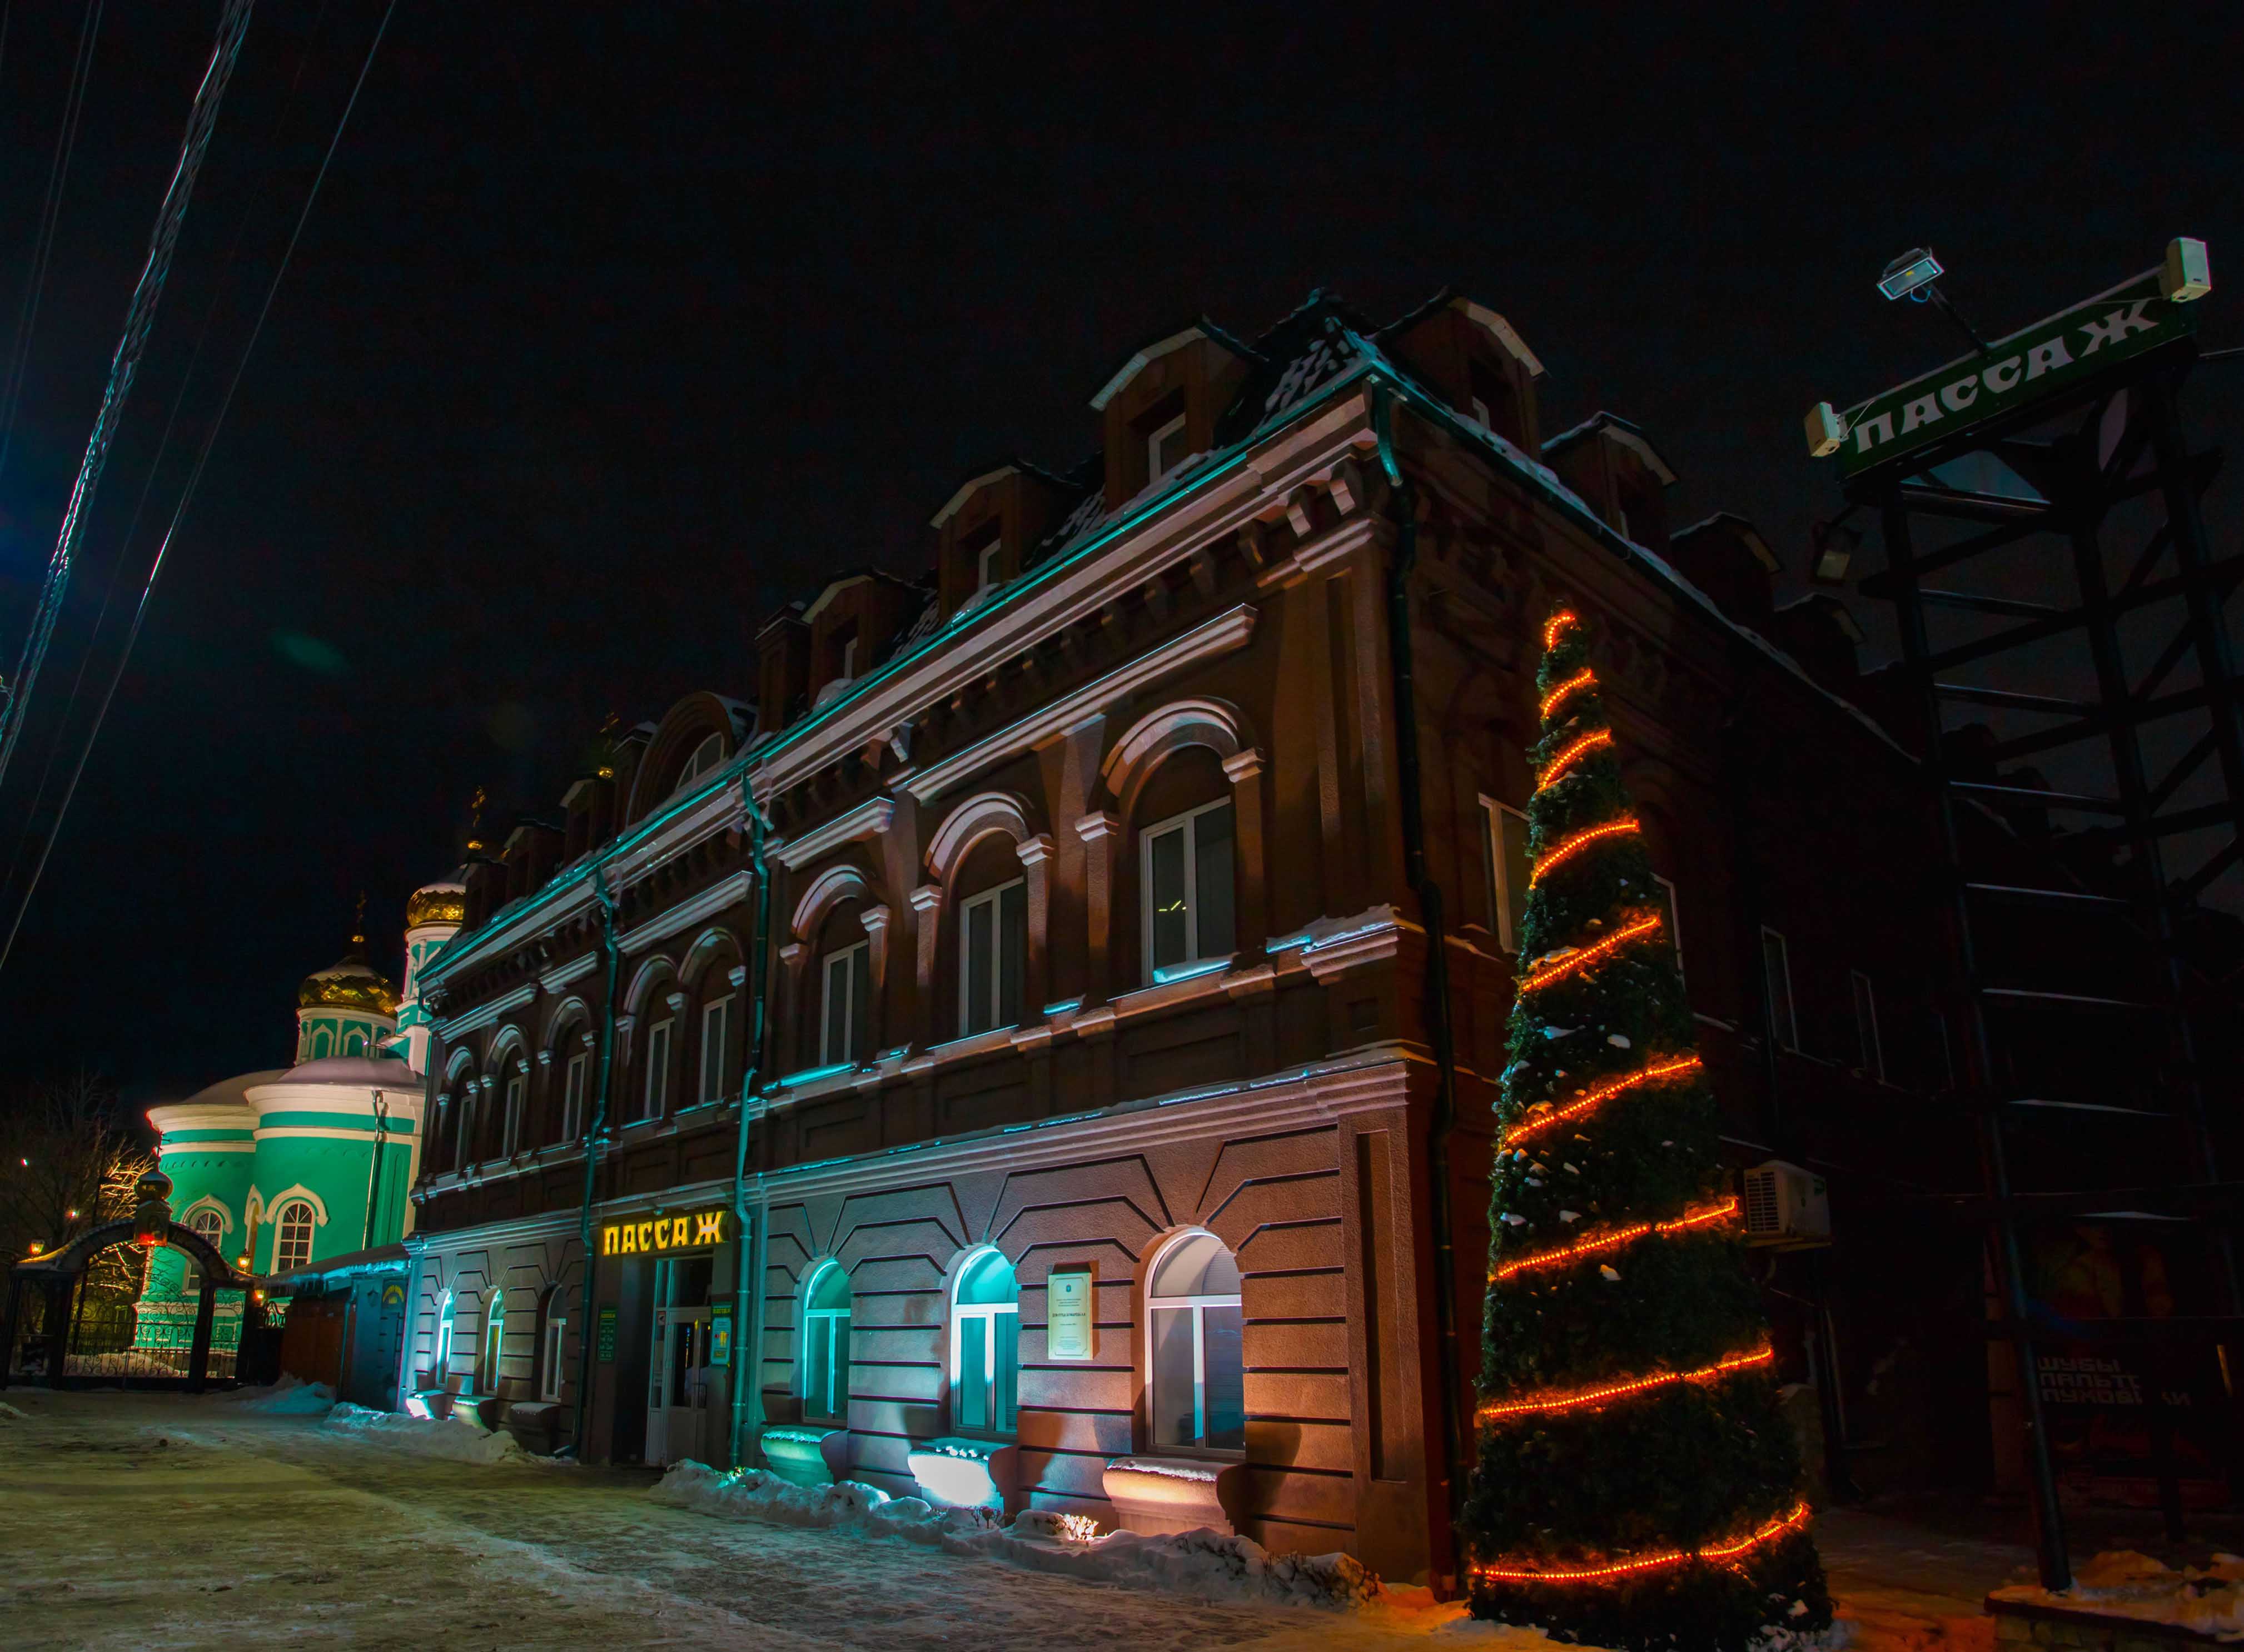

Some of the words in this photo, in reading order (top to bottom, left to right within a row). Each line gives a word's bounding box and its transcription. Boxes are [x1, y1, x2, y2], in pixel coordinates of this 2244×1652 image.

[1853, 301, 2160, 454] ПАССАЖ
[603, 1210, 727, 1256] ПАССАЖ
[2037, 1356, 2122, 1374] ШУБЫ
